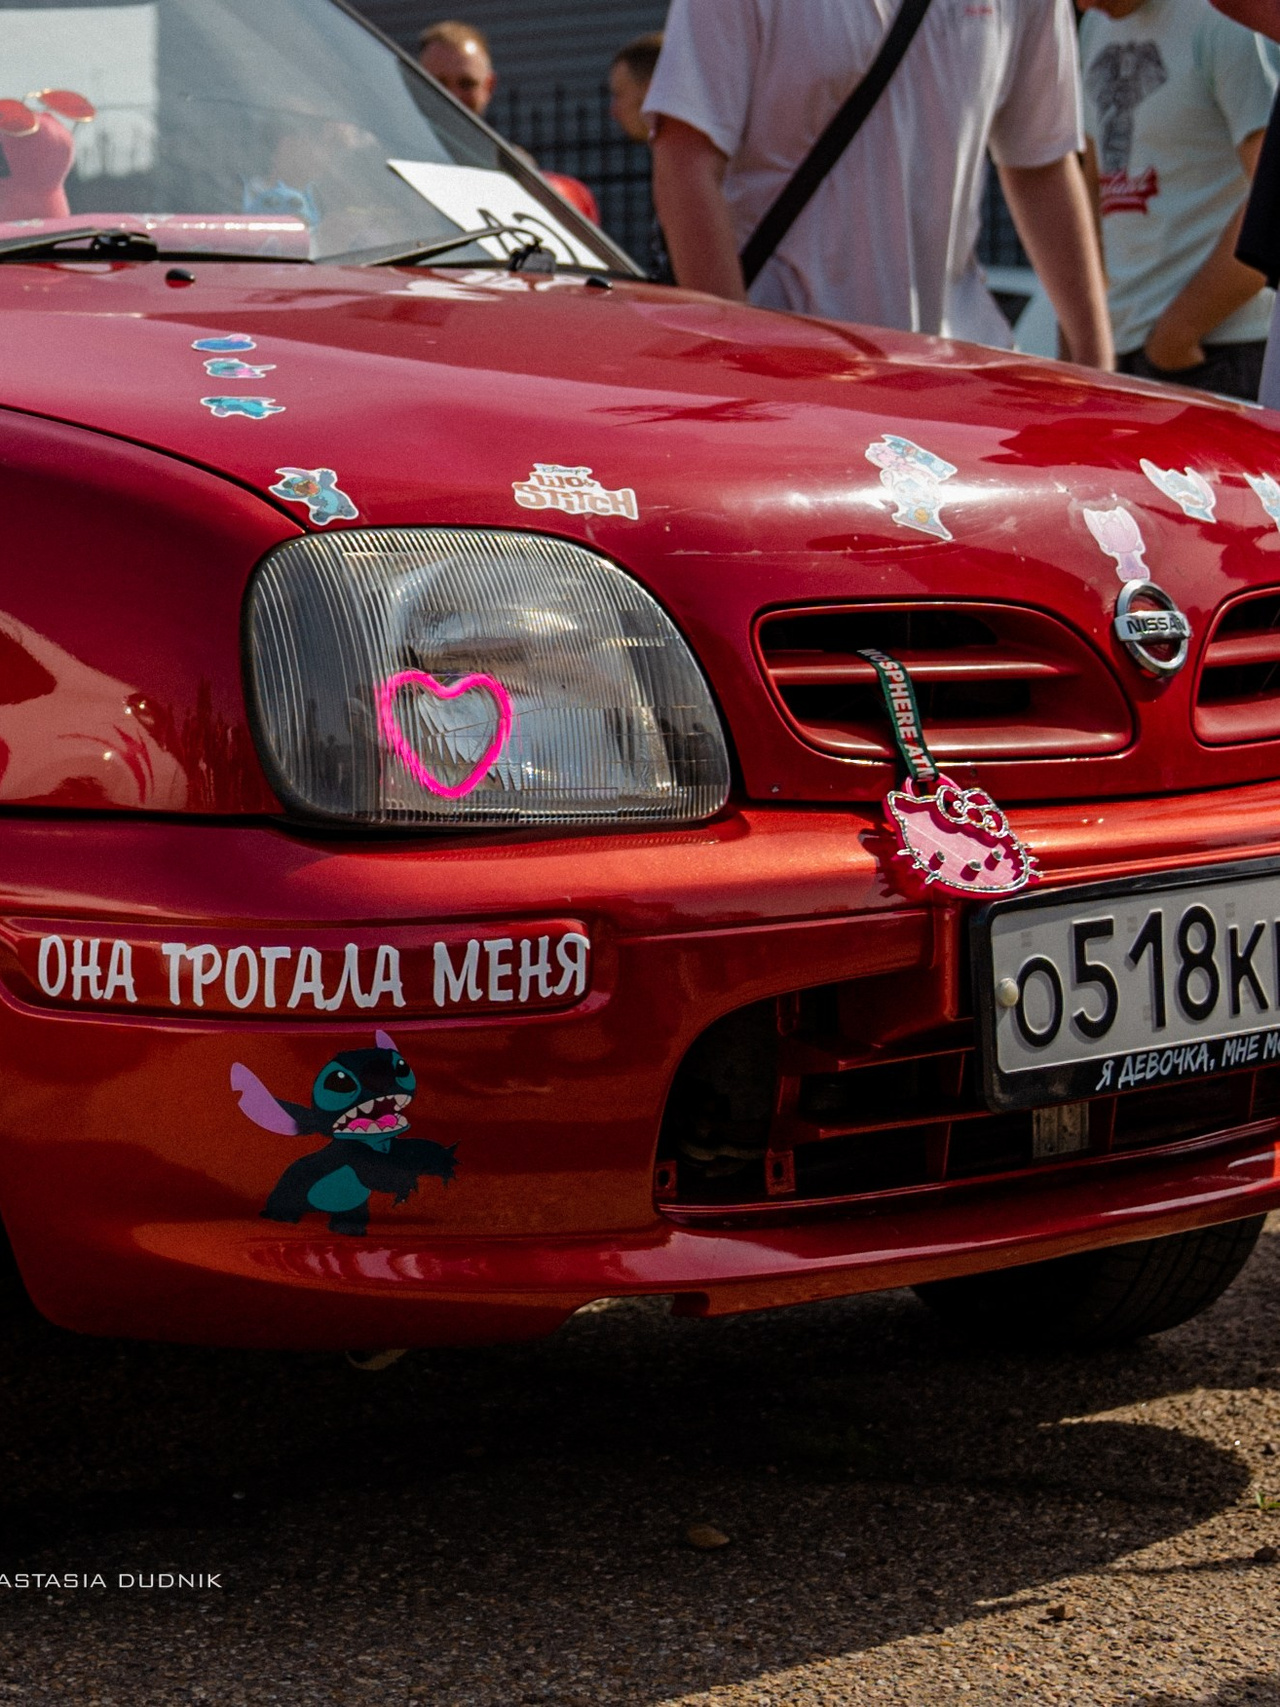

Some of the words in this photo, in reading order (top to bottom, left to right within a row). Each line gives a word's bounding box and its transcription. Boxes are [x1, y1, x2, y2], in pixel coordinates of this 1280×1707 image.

[1126, 613, 1187, 634] NISSAN
[37, 935, 137, 1003] ОНА
[162, 942, 407, 1012] ТРОГАЛА
[433, 933, 592, 1007] МЕНЯ
[1015, 902, 1280, 1048] О518К
[1095, 1059, 1115, 1091] Я
[1118, 1043, 1215, 1089] ДЕВОЧКА,
[1221, 1035, 1260, 1067] МНЕ
